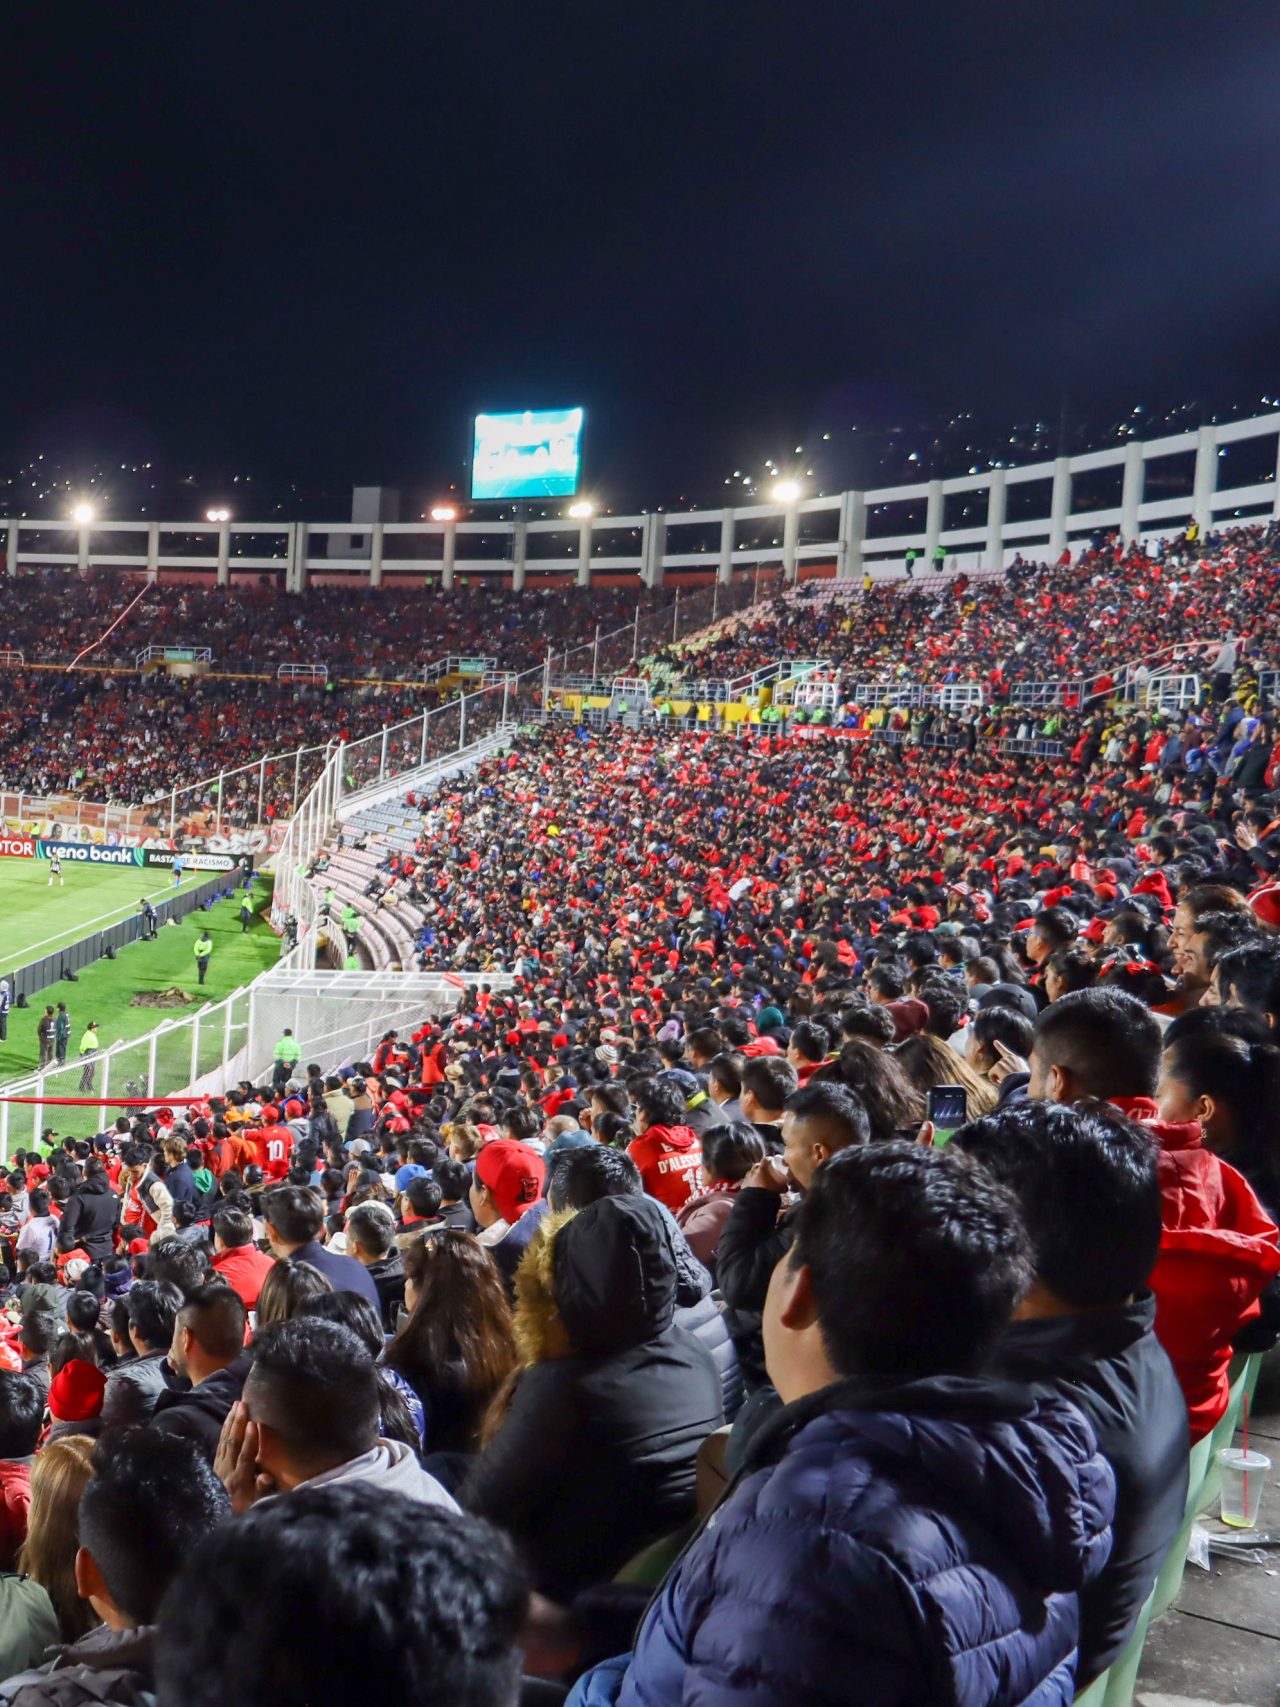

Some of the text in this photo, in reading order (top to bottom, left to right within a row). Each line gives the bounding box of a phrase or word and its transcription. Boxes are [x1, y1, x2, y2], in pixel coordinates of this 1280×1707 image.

[90, 845, 132, 863] bank
[149, 854, 174, 863] BASTA
[193, 857, 229, 867] RACISMO
